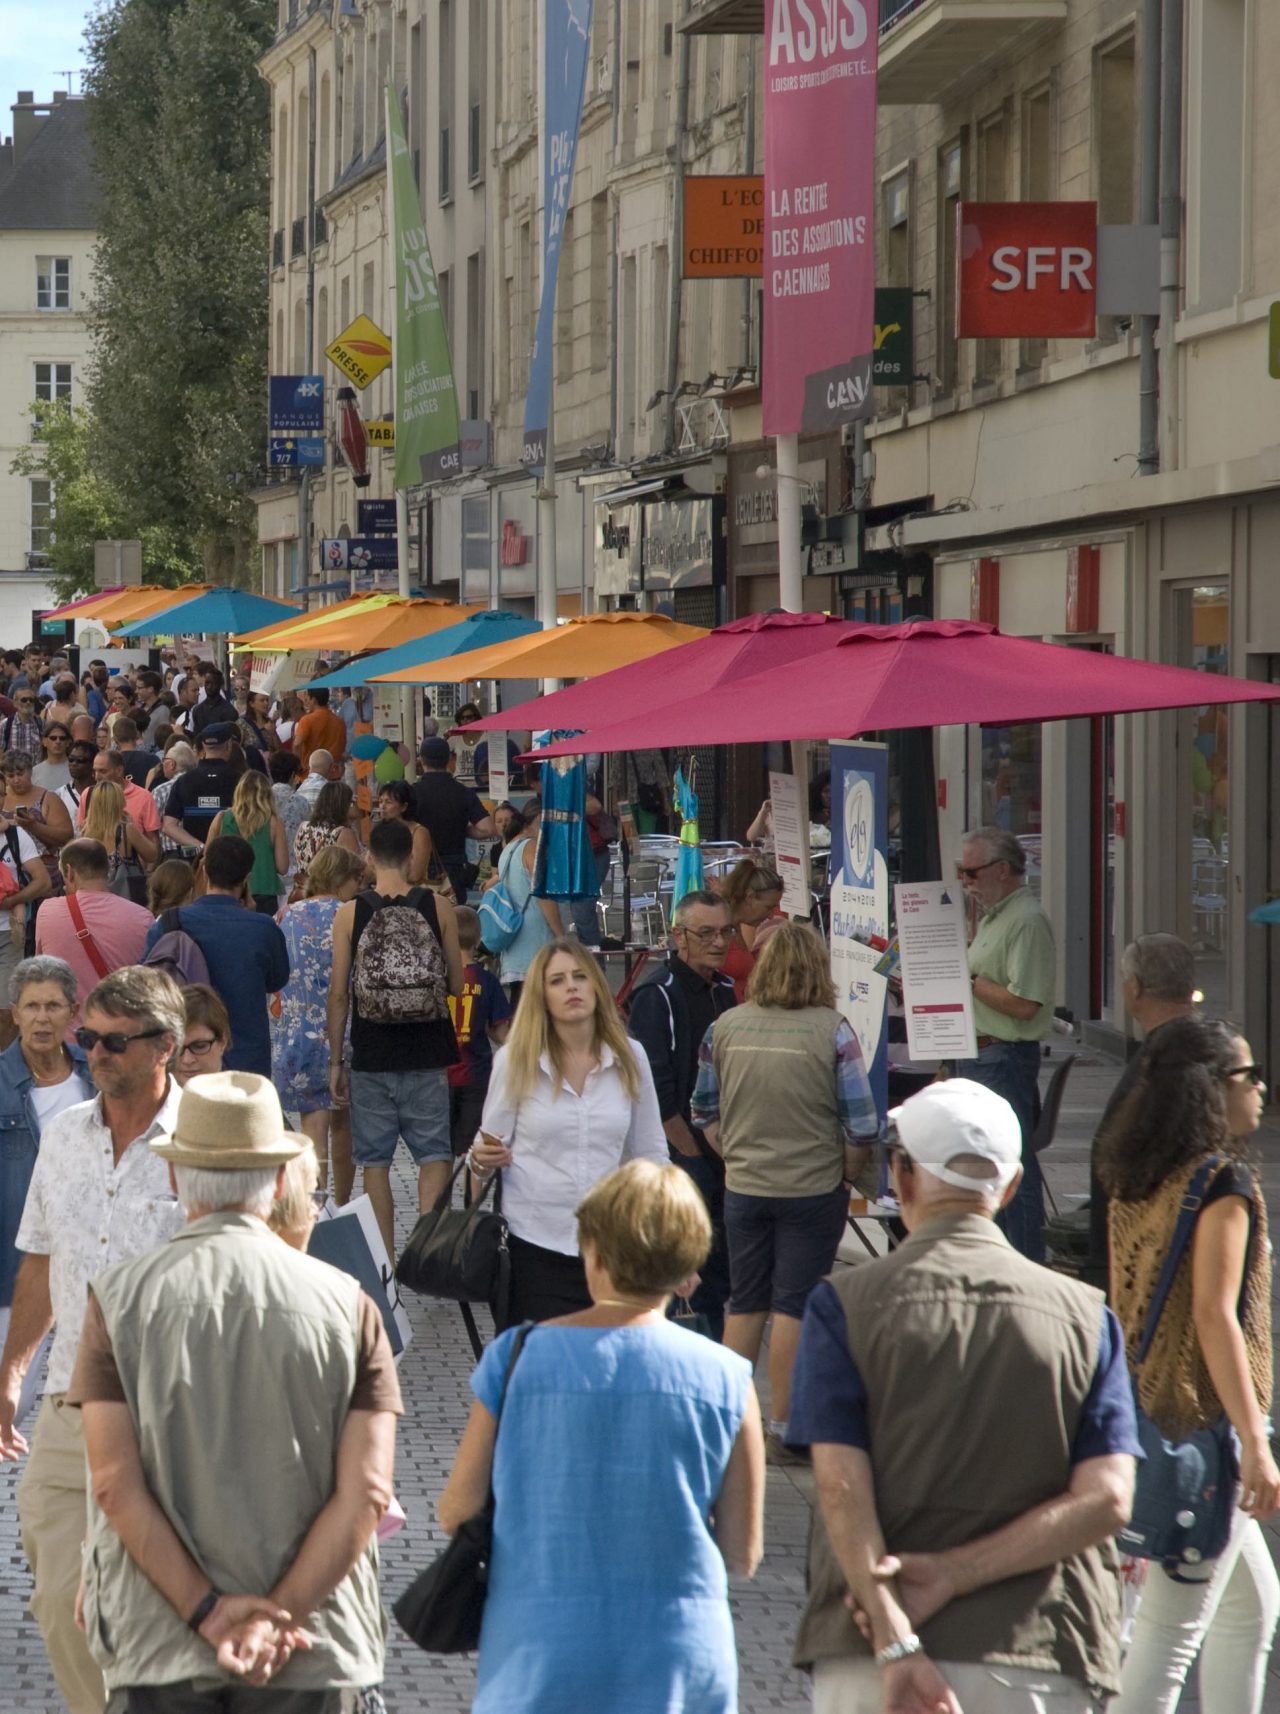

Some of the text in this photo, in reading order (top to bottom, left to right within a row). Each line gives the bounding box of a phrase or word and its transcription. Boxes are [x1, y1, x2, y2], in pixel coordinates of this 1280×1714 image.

[771, 188, 790, 218] LA
[771, 227, 799, 257] DES
[991, 245, 1094, 292] SFR
[331, 345, 369, 384] PRESSE
[276, 453, 291, 464] 7/7
